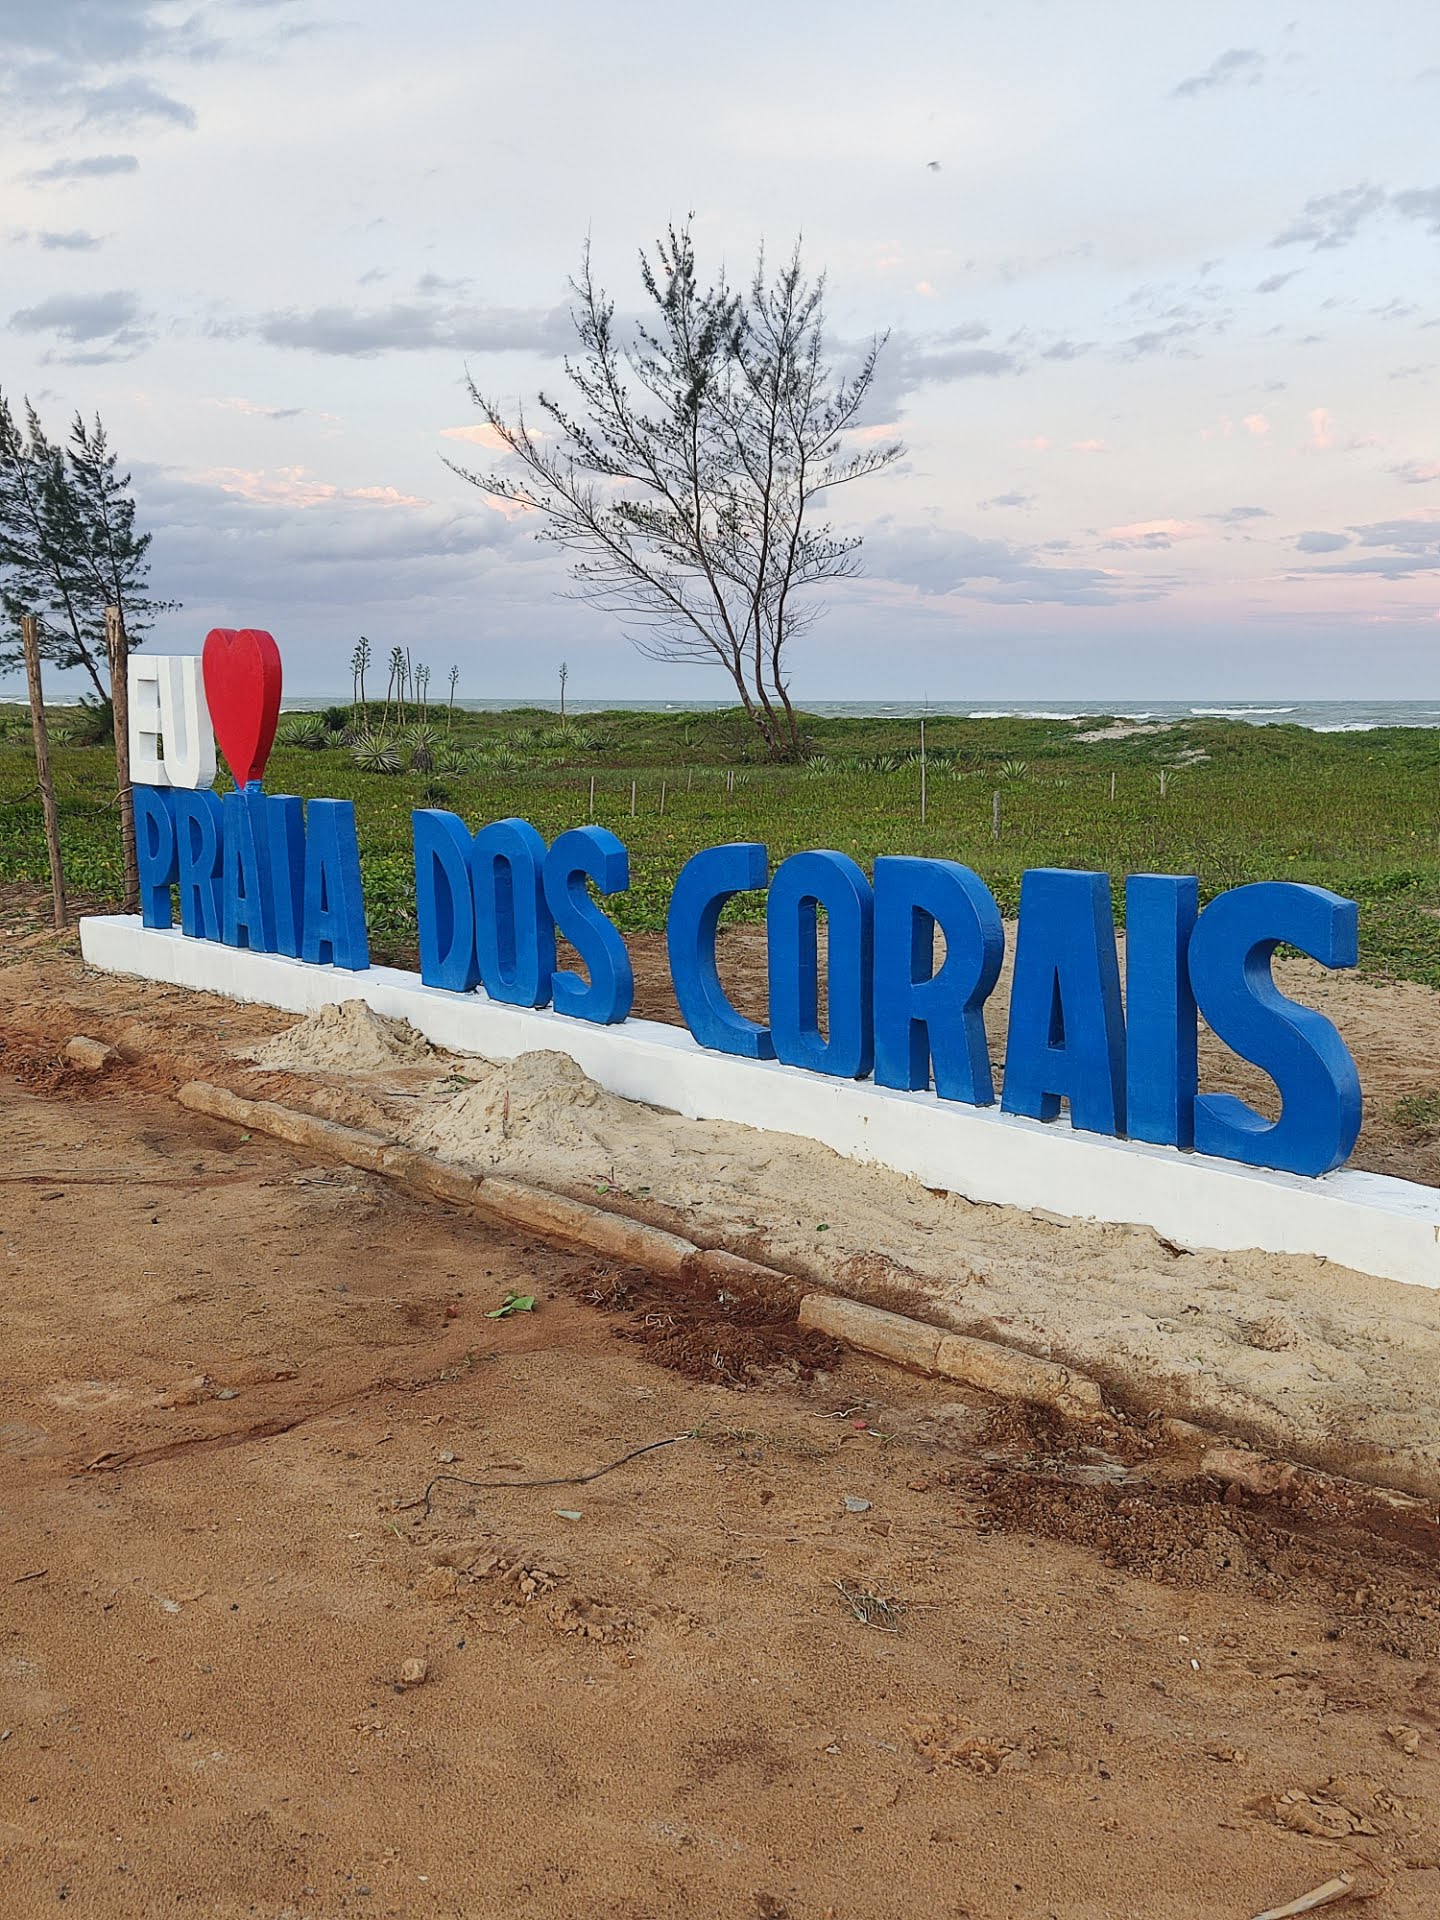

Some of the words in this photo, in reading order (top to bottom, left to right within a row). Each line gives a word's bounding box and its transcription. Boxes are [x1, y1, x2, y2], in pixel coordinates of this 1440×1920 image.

[128, 654, 216, 790] EU
[132, 783, 370, 971] PRAIA
[412, 808, 634, 1025] DOS
[668, 842, 1362, 1177] CORAIS
